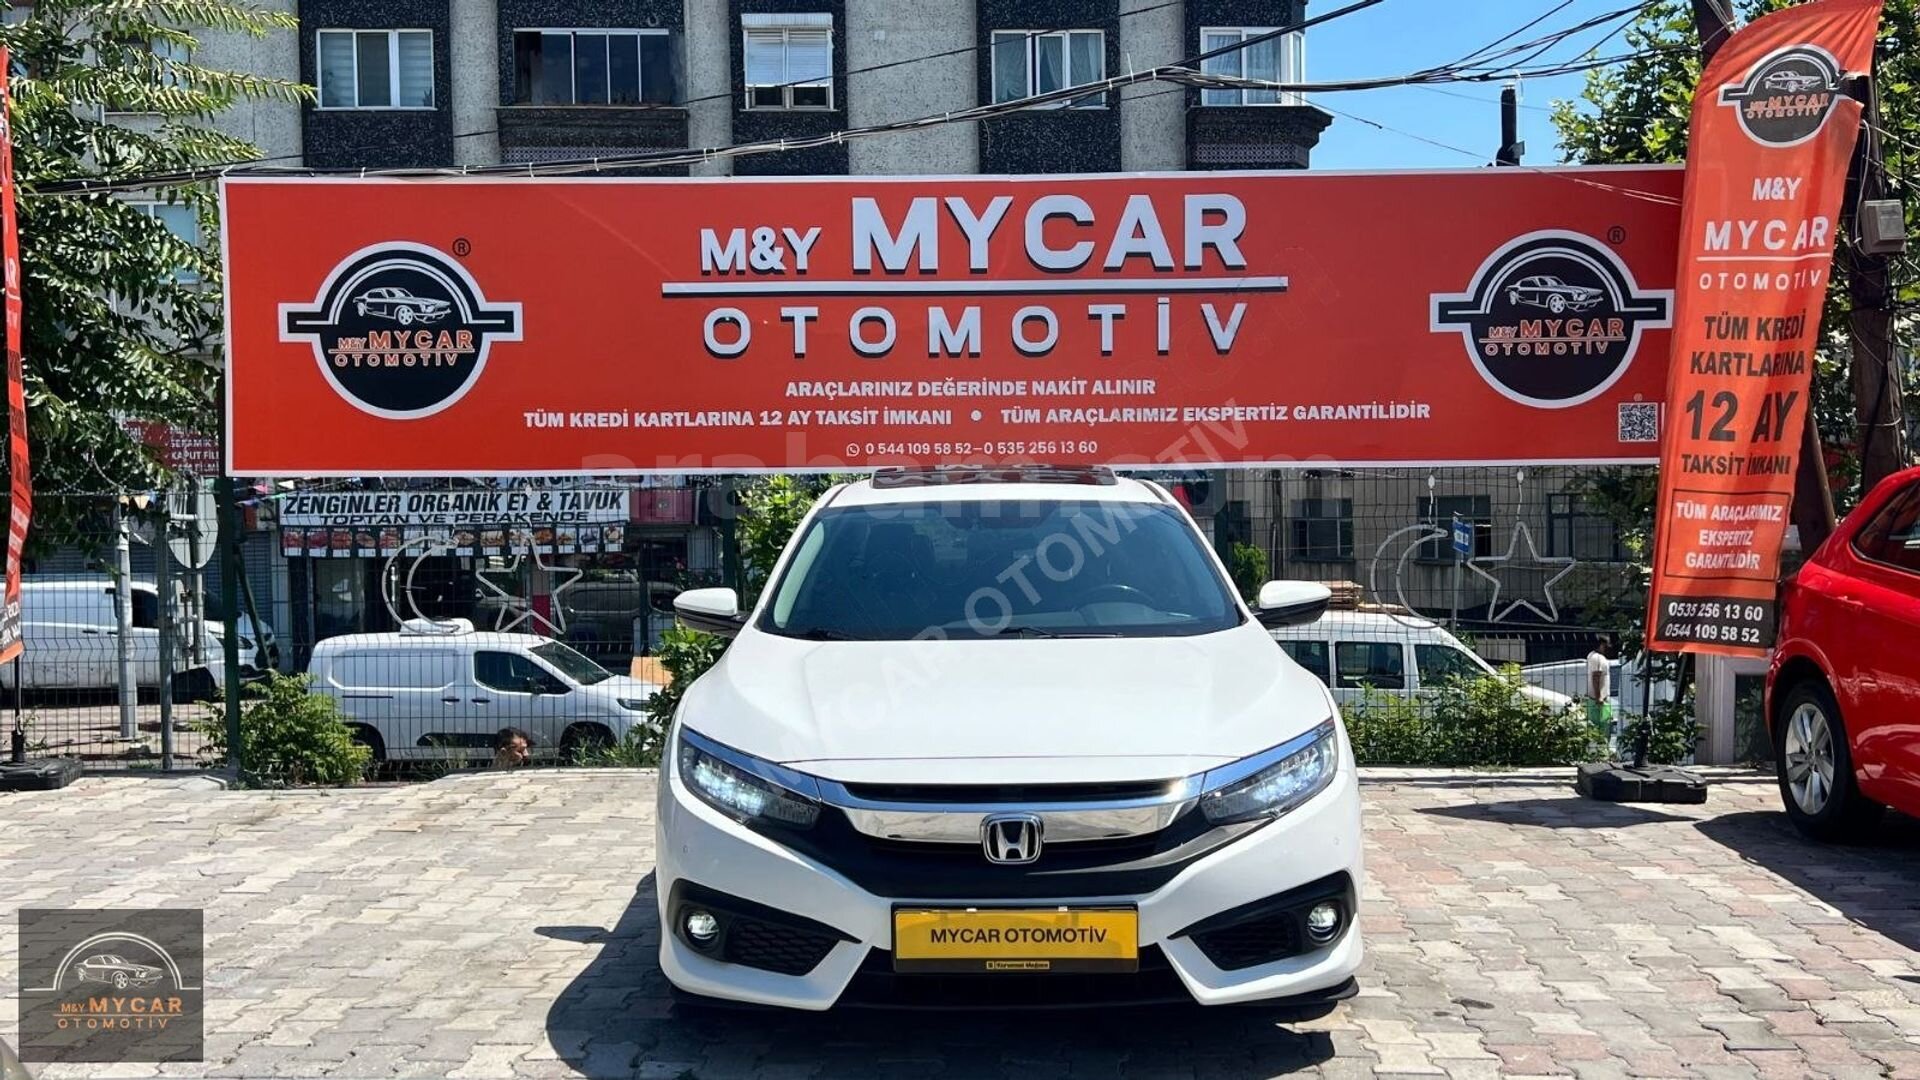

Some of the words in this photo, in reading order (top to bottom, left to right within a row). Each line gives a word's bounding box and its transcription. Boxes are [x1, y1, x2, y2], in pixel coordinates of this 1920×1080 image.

[1752, 177, 1802, 201] M&Y
[701, 226, 822, 275] M&Y
[852, 193, 1248, 275] MYCAR
[1704, 216, 1829, 251] MYCAR
[704, 297, 1248, 358] OTOMOTİV
[1488, 326, 1518, 339] M&Y
[1520, 318, 1624, 338] MYCAR
[1704, 311, 1749, 341] TÜM
[1756, 309, 1807, 341] KREDİ
[338, 337, 367, 350] M&Y
[368, 330, 473, 350] MYCAR
[1690, 351, 1805, 377] KARTLARINA
[785, 381, 913, 400] ARAÇLARINIZ
[918, 377, 1027, 397] DEĞERİNDE
[1032, 376, 1088, 396] NAKİT
[1091, 379, 1156, 395] ALINIR
[523, 408, 564, 427] TÜM
[570, 408, 629, 428] KREDİ
[634, 410, 754, 428] KARTLARINA
[759, 410, 782, 426] 12
[788, 409, 812, 426] AY
[816, 405, 879, 426] TAKSİT
[883, 405, 952, 425] İMKANI
[1001, 406, 1041, 424] TÜM
[1045, 407, 1178, 427] ARAÇLARIMIZ
[1183, 402, 1288, 422] EKSPERTİZ
[1293, 400, 1430, 421] GARANTİLİDİR
[1686, 390, 1738, 442] 12
[1751, 390, 1799, 444] AY
[865, 442, 874, 455] 0
[878, 442, 905, 455] 544
[907, 442, 930, 454] 109
[934, 442, 951, 454] 58
[997, 441, 1025, 454] 535
[1028, 441, 1056, 454] 256
[1060, 441, 1075, 454] 13
[1078, 440, 1098, 454] 60
[1682, 452, 1745, 476] TAKSİT
[537, 492, 550, 511] &
[558, 490, 622, 511] TAVUK
[320, 514, 410, 526] TOPTAN
[418, 514, 447, 524] VE
[455, 511, 588, 525] PERAKENDE
[1676, 500, 1707, 520] TÜM
[1711, 503, 1784, 526] ARAÇLARIMIZ
[1698, 528, 1753, 547] EKSPERTİZ
[1685, 551, 1761, 570] GARANTİLİDİR
[1668, 602, 1698, 617] 0535
[1698, 603, 1720, 618] 256
[1724, 604, 1741, 619] 13
[1744, 605, 1763, 621] 60
[1665, 623, 1691, 637] 0544
[1694, 624, 1717, 640] 109
[1721, 626, 1738, 641] 58
[1741, 628, 1760, 643] 52
[930, 929, 1000, 943] MYCAR
[1004, 925, 1108, 943] OTOMOTİV
